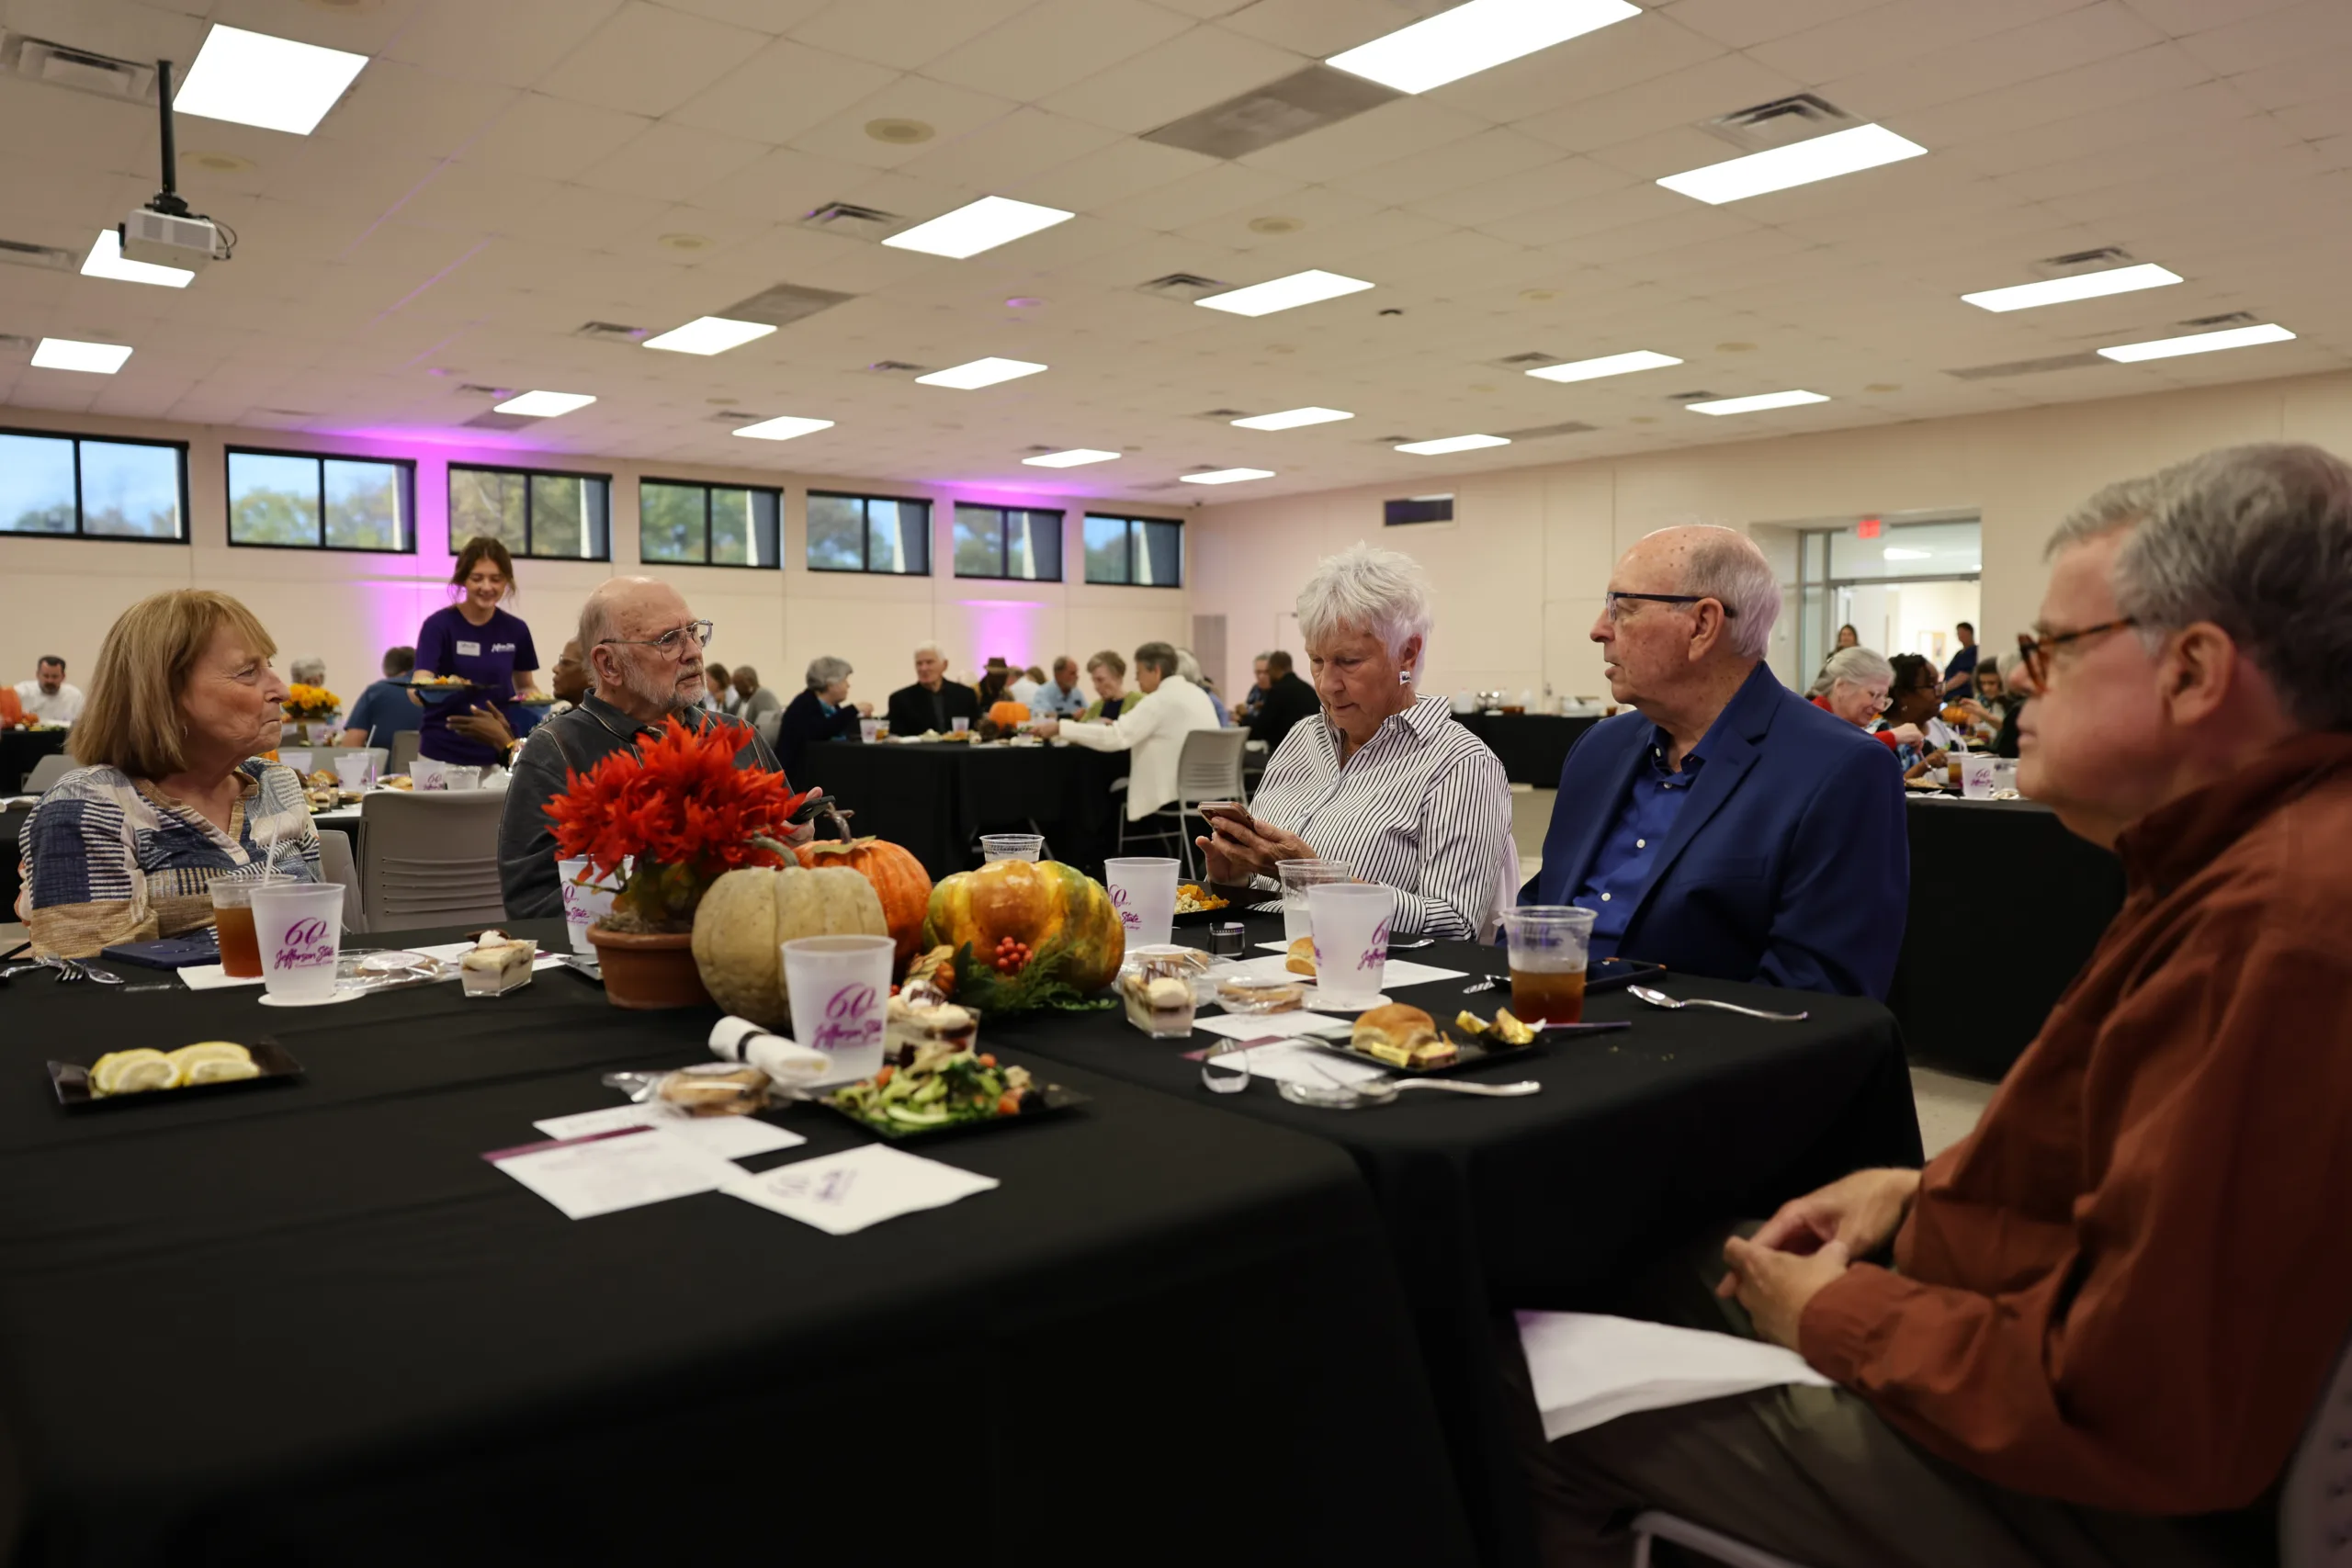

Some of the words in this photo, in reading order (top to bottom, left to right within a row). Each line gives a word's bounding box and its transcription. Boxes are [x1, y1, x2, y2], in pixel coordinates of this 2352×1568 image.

[284, 917, 327, 946] 60
[1122, 911, 1142, 925] State
[826, 982, 877, 1021] 60
